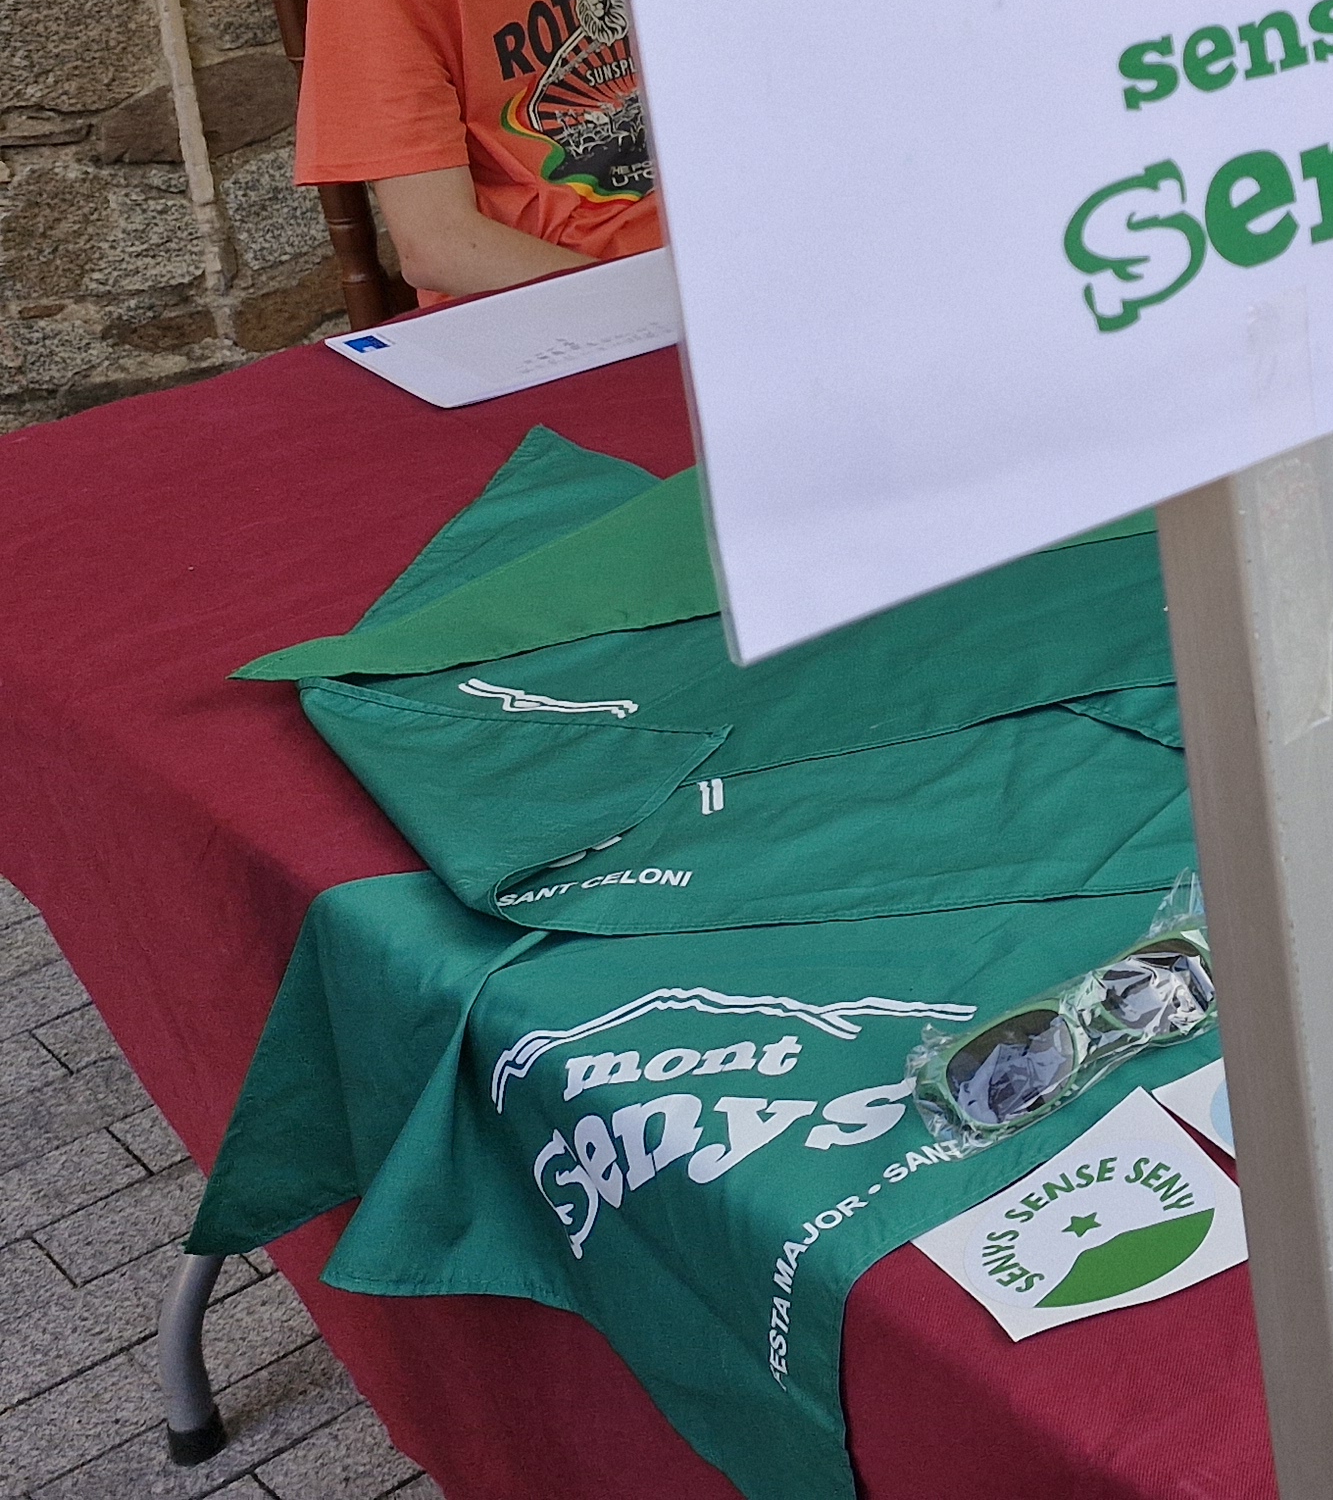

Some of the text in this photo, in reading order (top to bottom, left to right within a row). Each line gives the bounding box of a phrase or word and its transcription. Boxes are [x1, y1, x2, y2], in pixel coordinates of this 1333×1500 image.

[586, 56, 637, 87] SUNSPL
[611, 169, 655, 187] UTO
[498, 868, 693, 907] SANT CELONI
[564, 1035, 802, 1101] mont
[534, 1077, 917, 1259] Senys
[773, 1194, 869, 1295] MAJOR
[882, 1139, 963, 1184] SANT
[982, 1156, 1195, 1293] SENYS SENSE SENY
